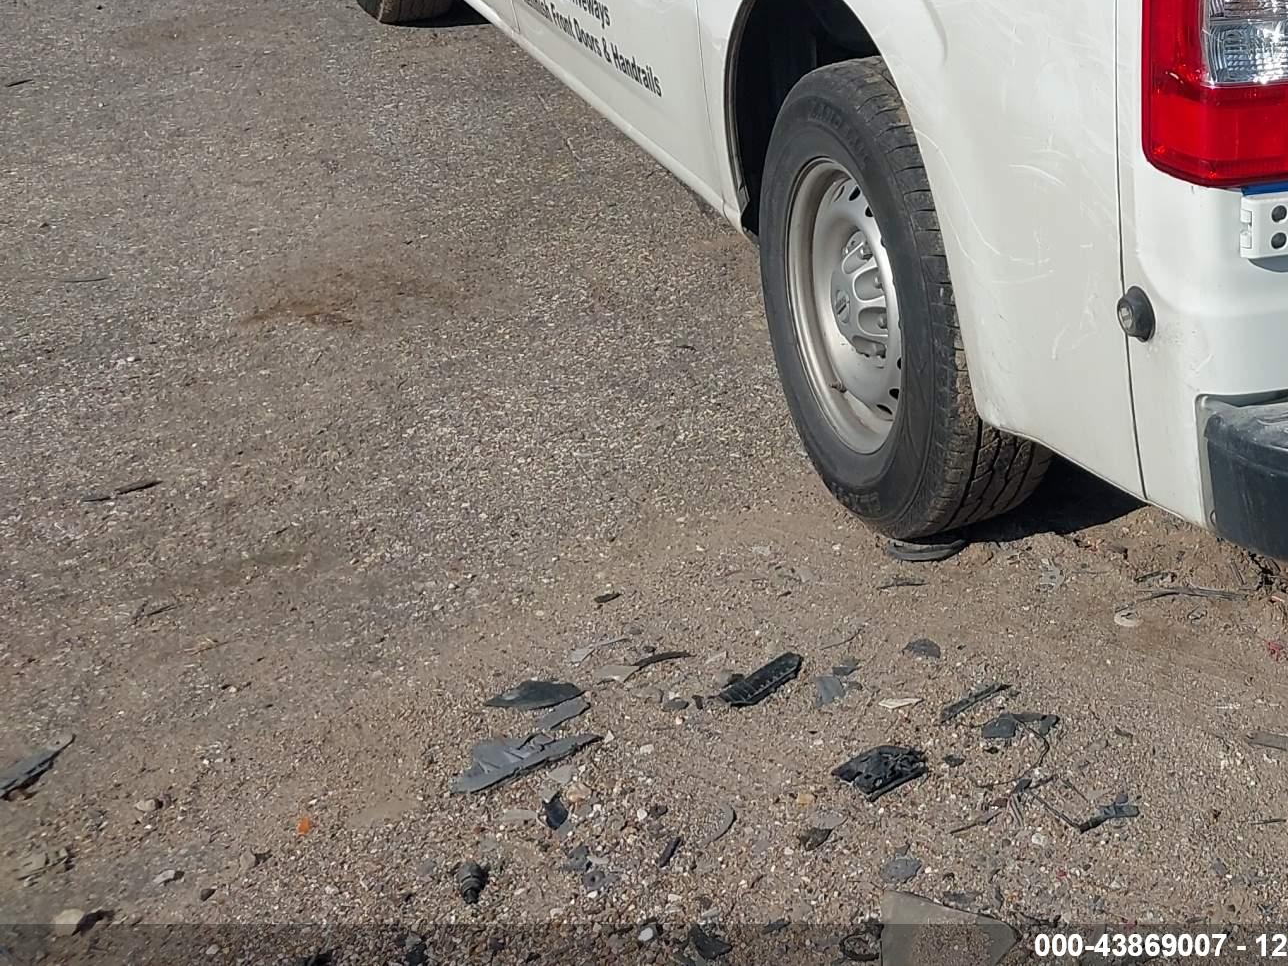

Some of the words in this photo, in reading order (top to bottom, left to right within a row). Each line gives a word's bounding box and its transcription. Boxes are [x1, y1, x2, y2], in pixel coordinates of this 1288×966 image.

[550, 2, 575, 38] Front
[573, 17, 602, 57] Doors
[602, 37, 612, 64] &
[610, 42, 662, 97] Handrails
